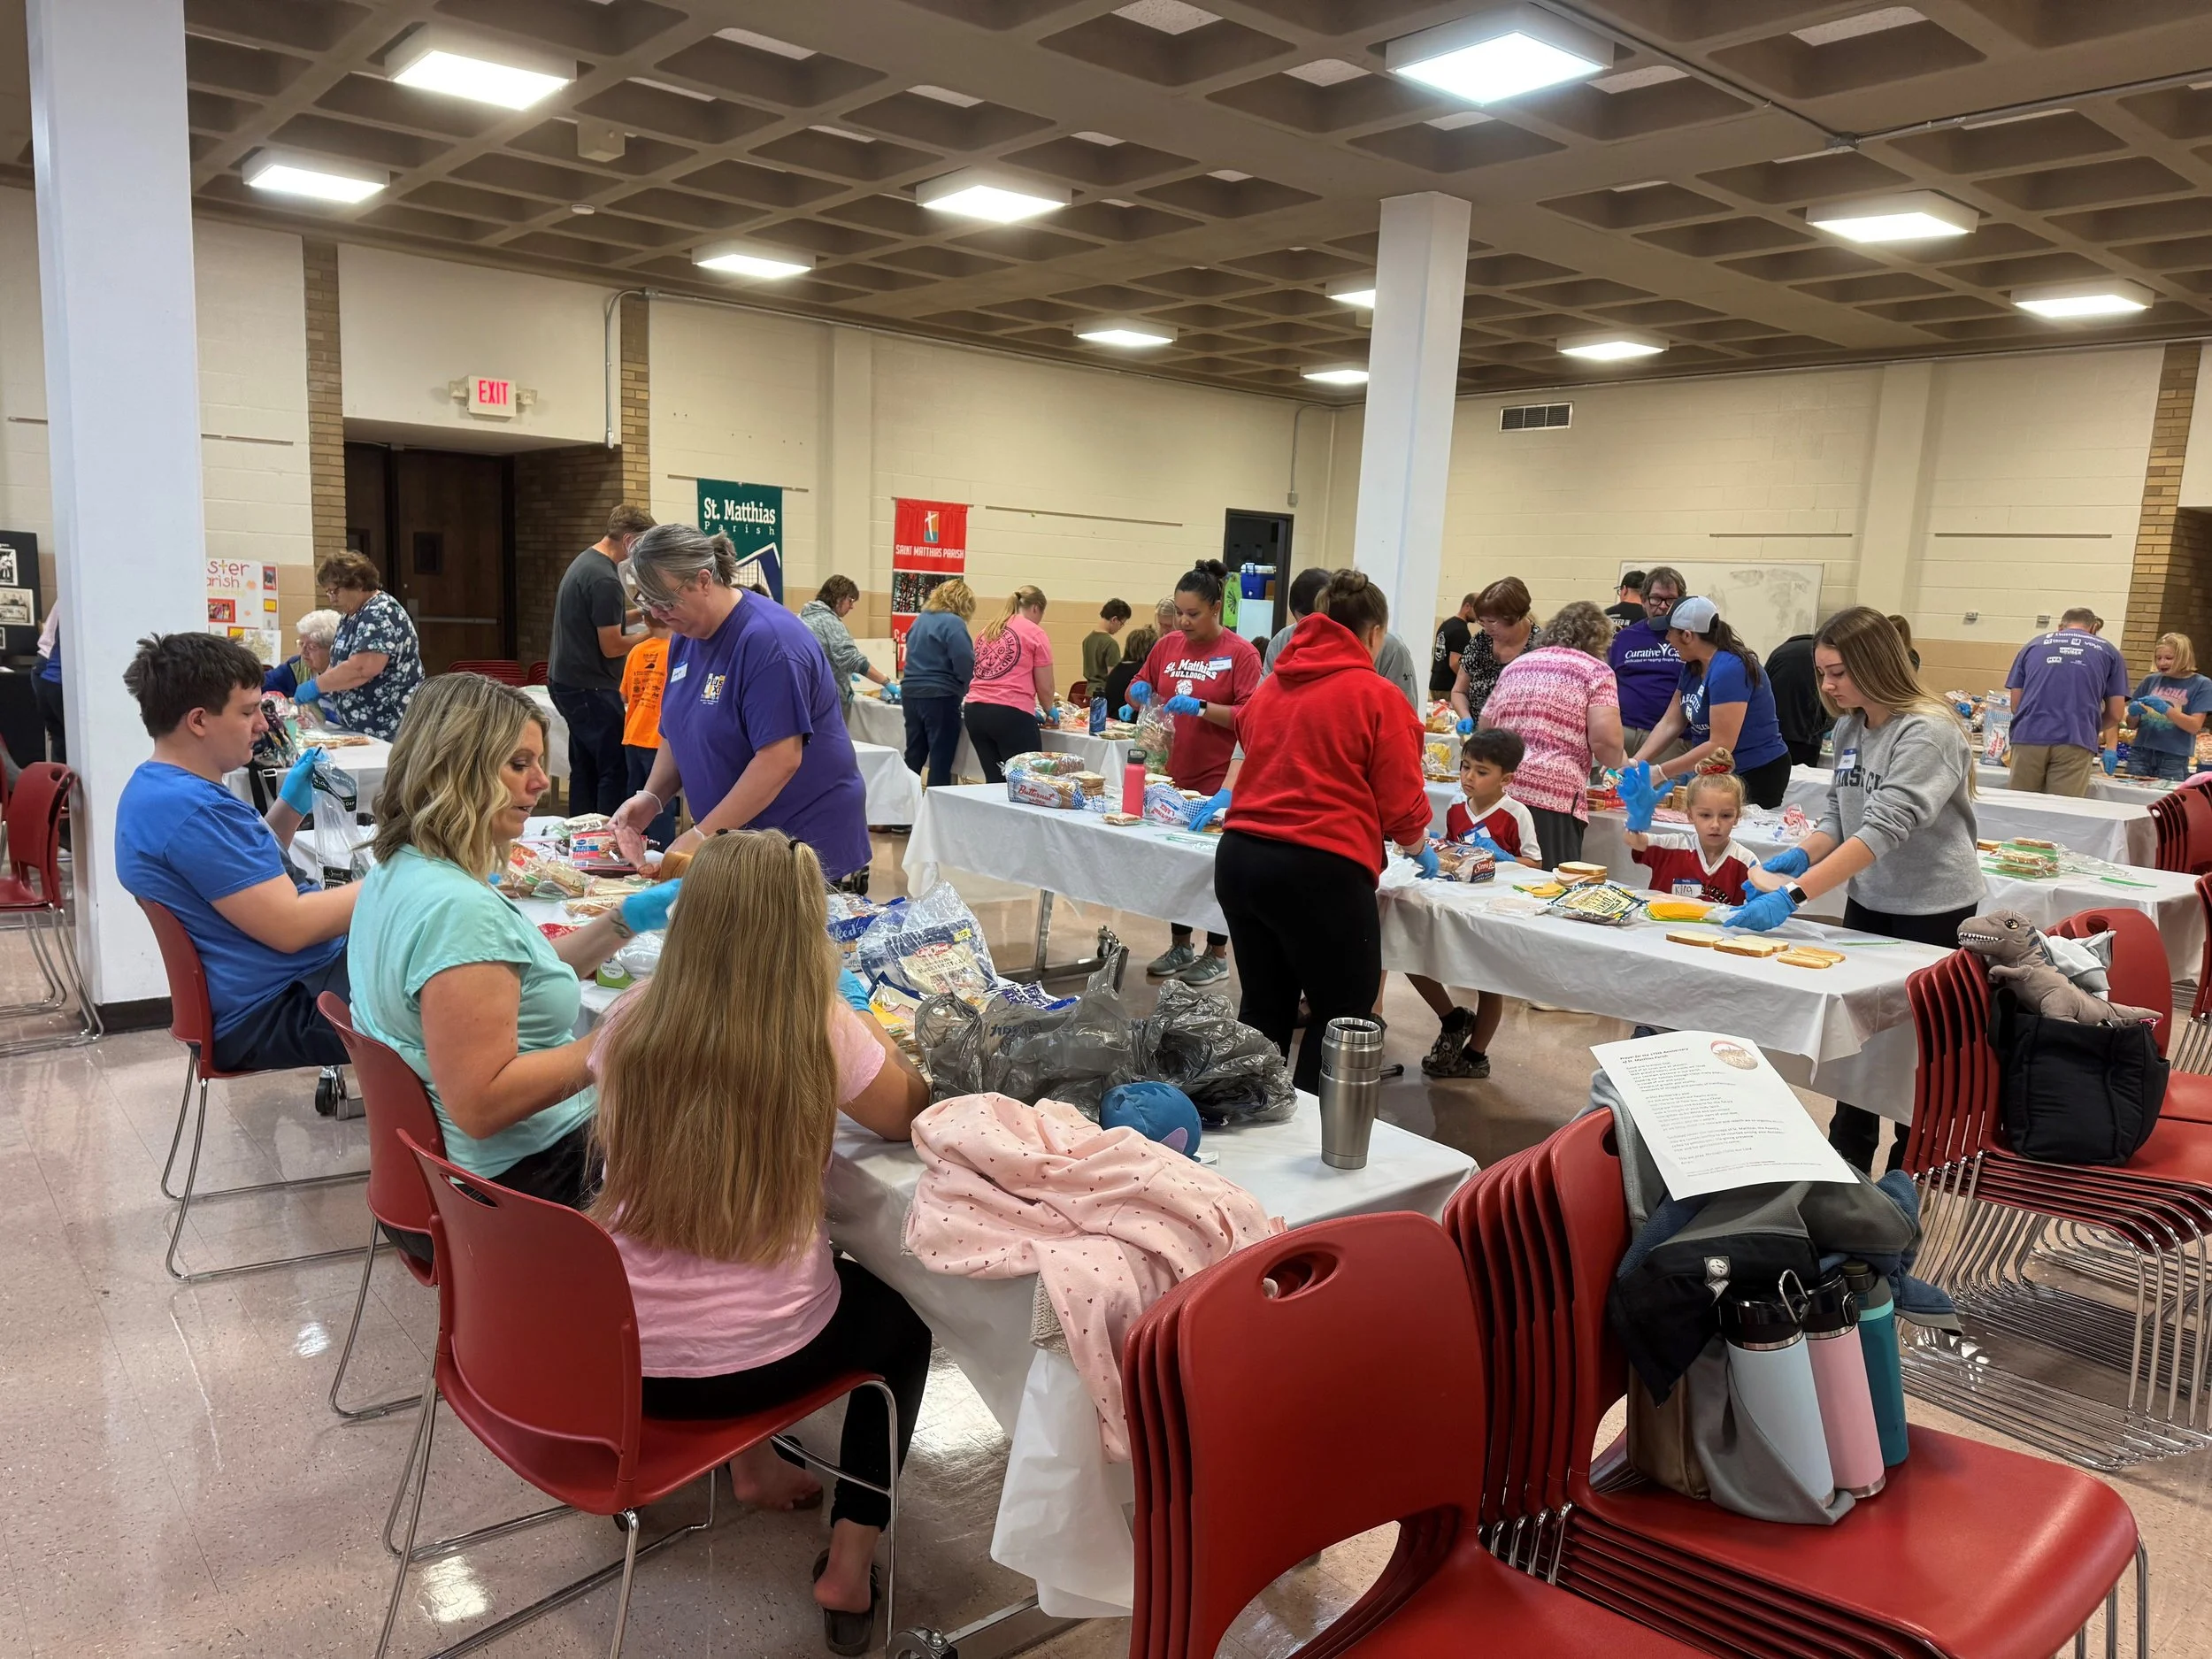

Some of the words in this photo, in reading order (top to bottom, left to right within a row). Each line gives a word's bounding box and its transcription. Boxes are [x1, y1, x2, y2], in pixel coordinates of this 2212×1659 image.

[479, 379, 509, 405] EXIT
[703, 496, 720, 520] St.
[724, 499, 776, 525] Matthias
[704, 520, 776, 536] Parish
[895, 544, 912, 556] SAINT
[913, 545, 942, 558] MATTHIAS
[942, 548, 964, 559] PARISH
[1624, 648, 1662, 659] Curative
[1170, 671, 1206, 681] BULLDOGS
[1018, 784, 1056, 801] Butternut
